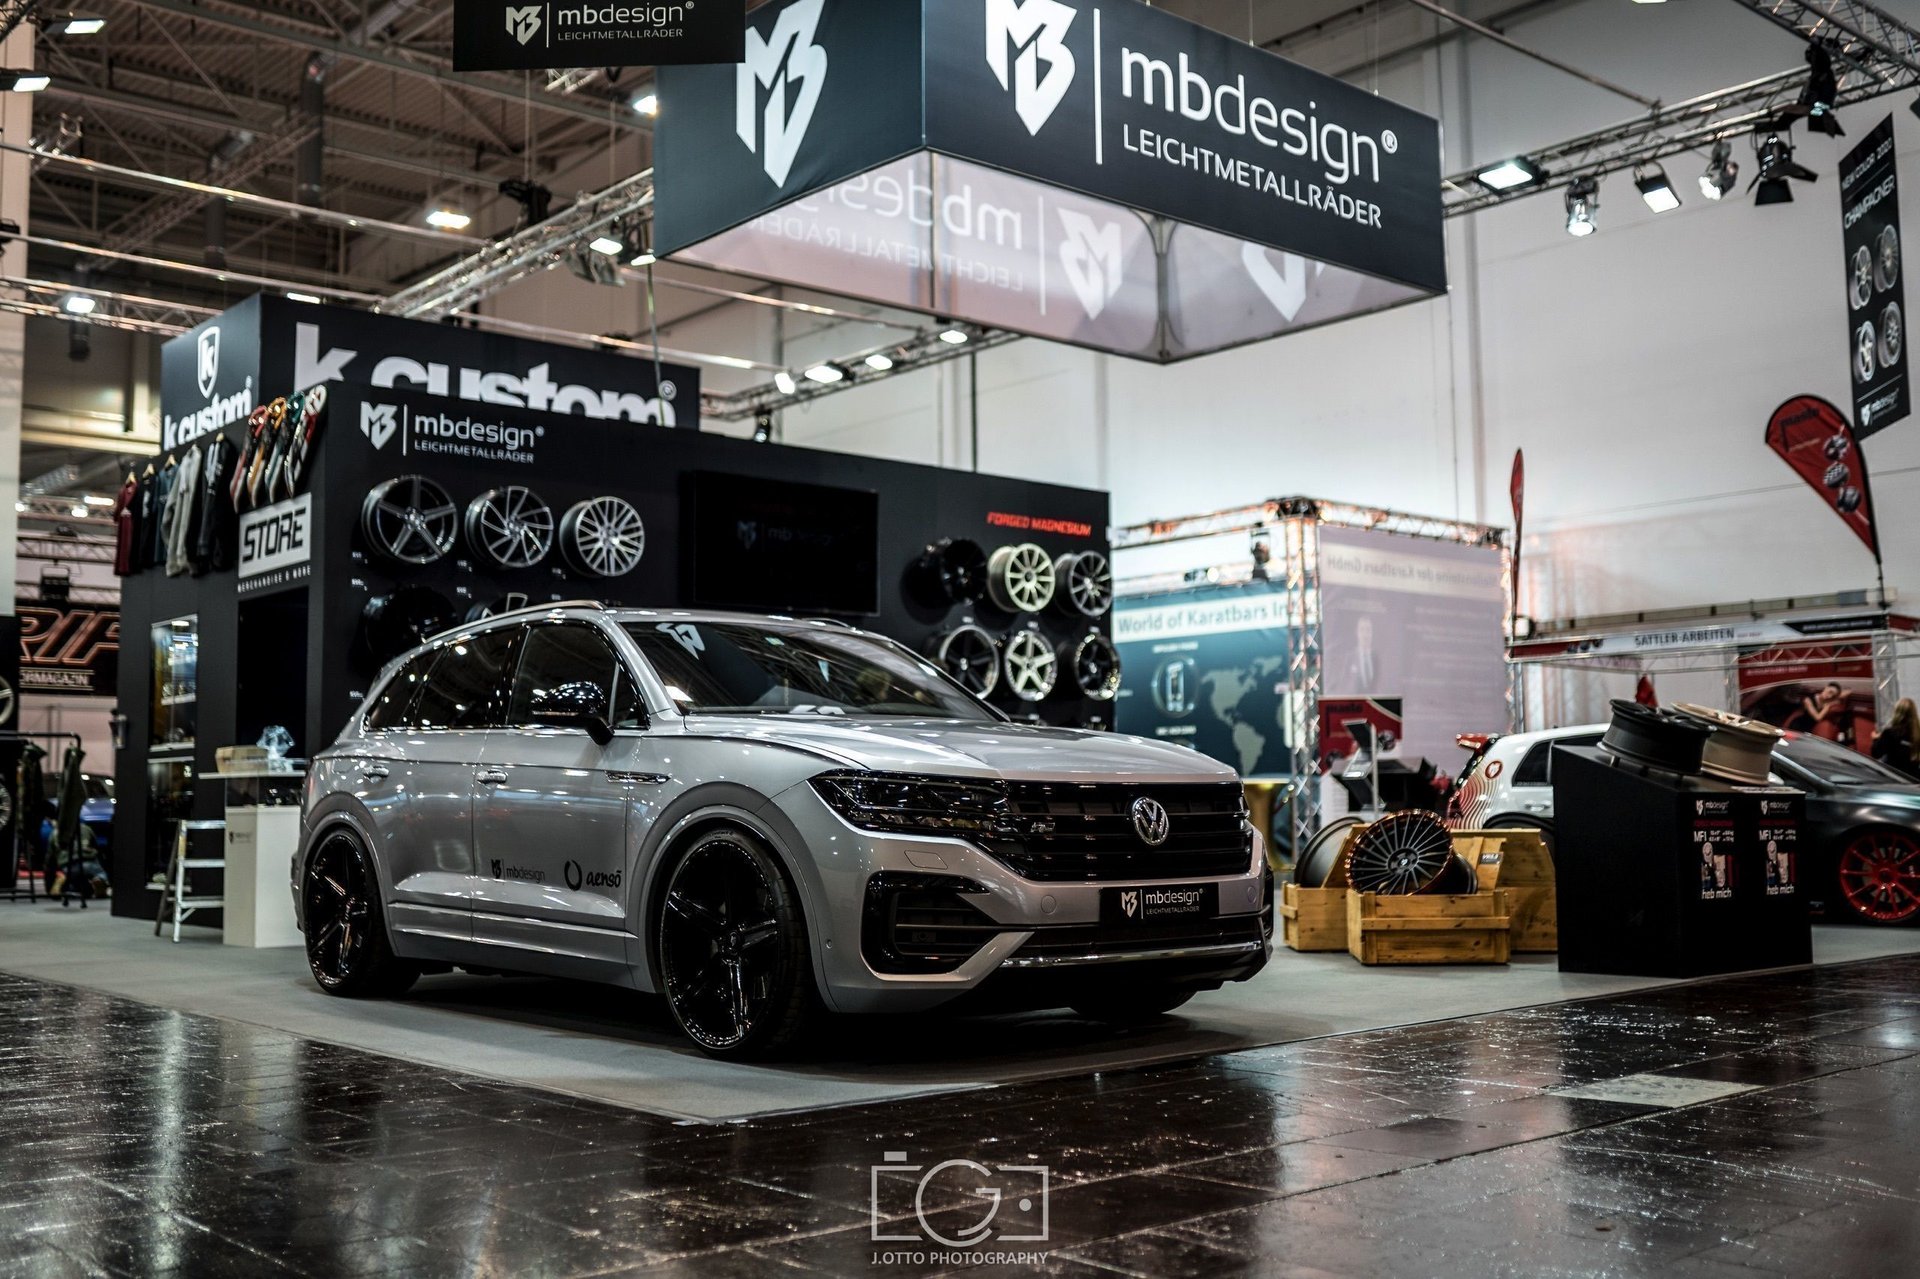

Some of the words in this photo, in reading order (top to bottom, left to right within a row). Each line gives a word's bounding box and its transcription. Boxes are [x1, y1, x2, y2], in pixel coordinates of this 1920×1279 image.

[1123, 123, 1381, 229] LEICHTMETALLRÄDER
[242, 507, 307, 564] STORE
[986, 511, 1031, 530] FORGED
[1030, 518, 1092, 537] MAGNESIUM
[1118, 612, 1163, 634] World
[1168, 610, 1183, 628] of
[1188, 603, 1267, 626] Karatbars
[506, 867, 545, 884] mbdesign
